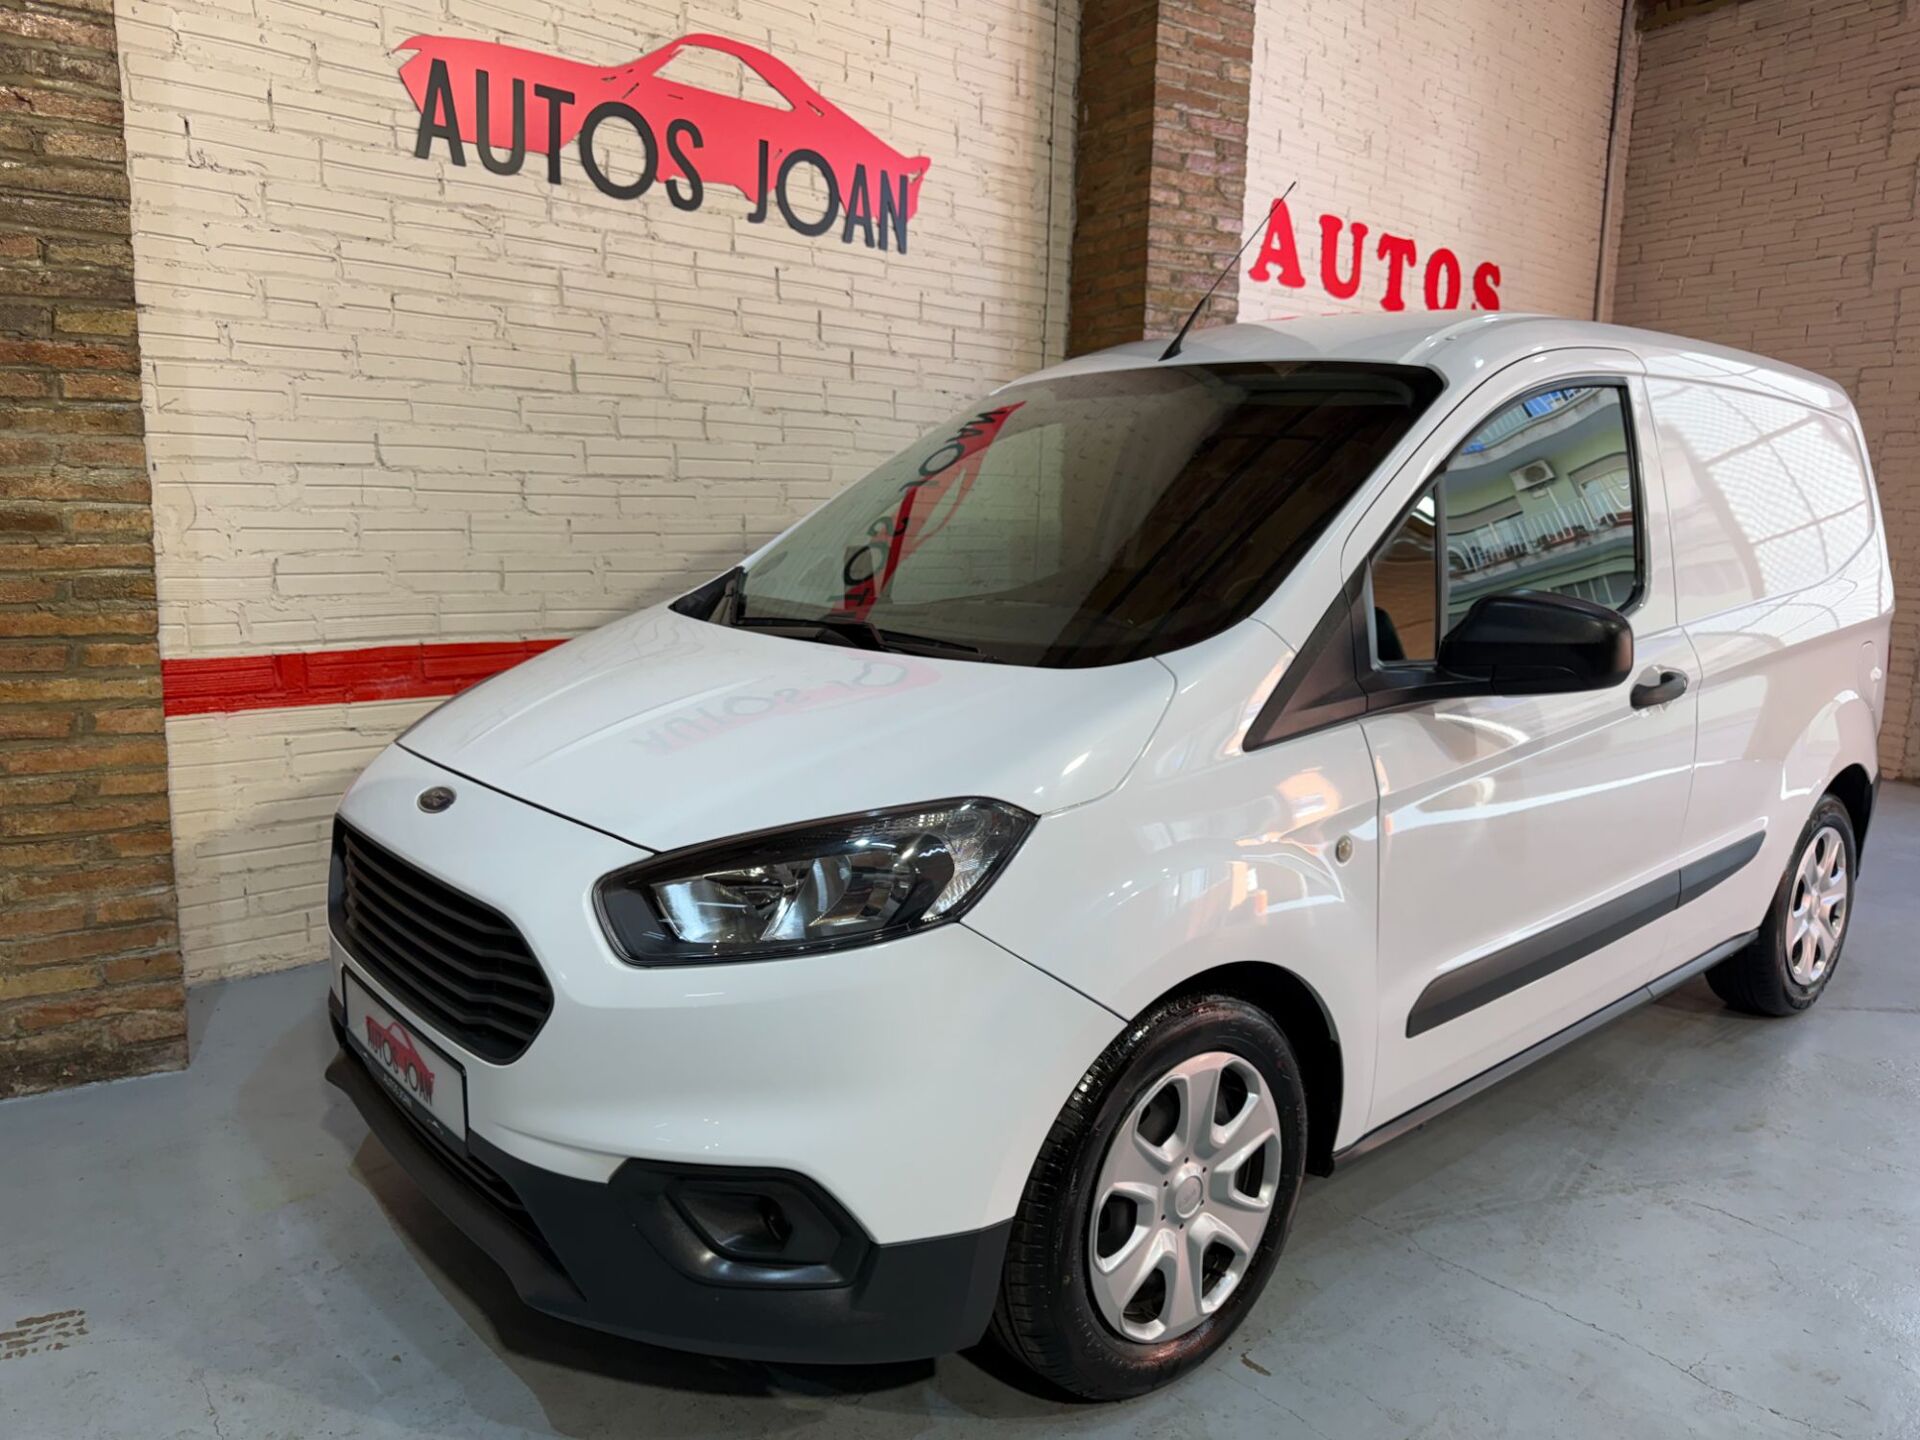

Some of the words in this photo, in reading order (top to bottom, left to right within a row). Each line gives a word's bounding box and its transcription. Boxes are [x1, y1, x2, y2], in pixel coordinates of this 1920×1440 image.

[414, 57, 704, 212] AUTOS
[747, 139, 908, 255] JOAN
[1248, 197, 1501, 312] AUTOS
[366, 1022, 399, 1074] AUTOS
[403, 1056, 434, 1106] JOAN
